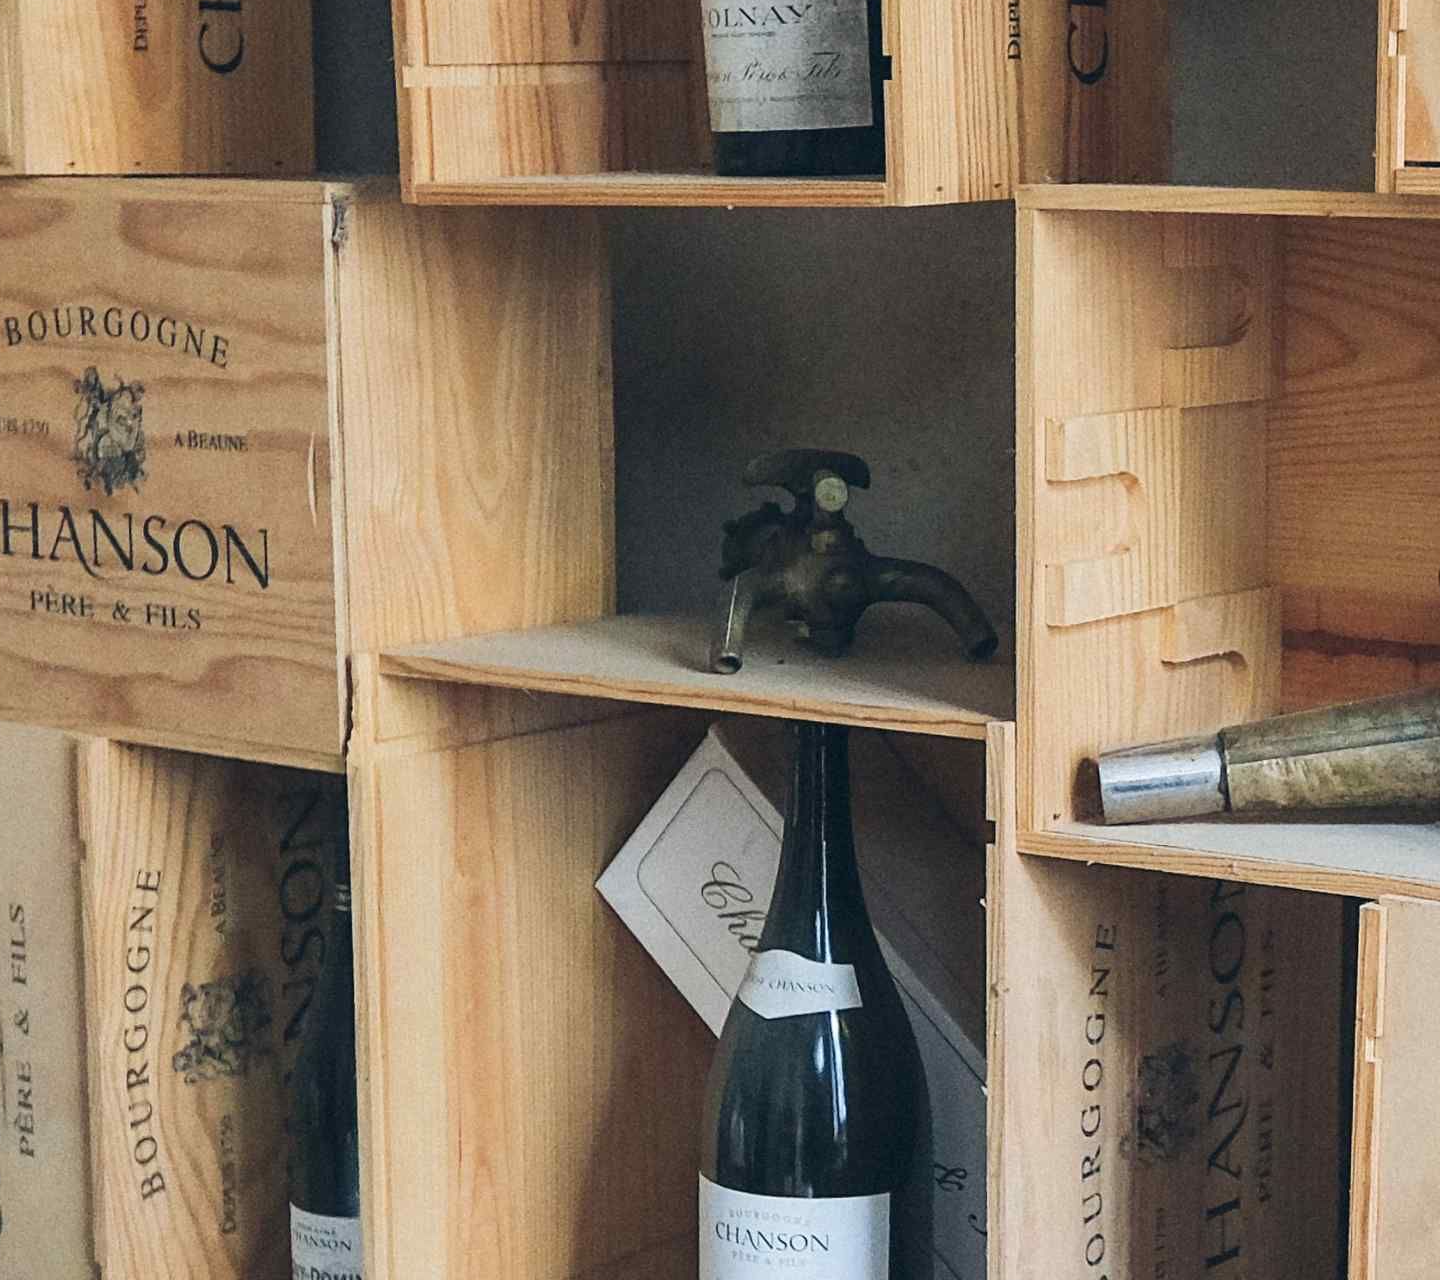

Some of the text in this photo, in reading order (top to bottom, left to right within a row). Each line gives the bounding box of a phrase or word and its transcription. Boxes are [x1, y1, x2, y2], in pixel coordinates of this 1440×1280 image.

[4, 306, 230, 370] BOURGOGNE
[188, 429, 249, 453] BEAUNE
[111, 598, 131, 622] &
[144, 602, 202, 631] FILS
[8, 902, 28, 987] FILS
[768, 976, 835, 994] CHANSON
[122, 868, 167, 1202] BOURGOGNE
[14, 1059, 36, 1160] PÈRE
[714, 1222, 830, 1253] CHANSON
